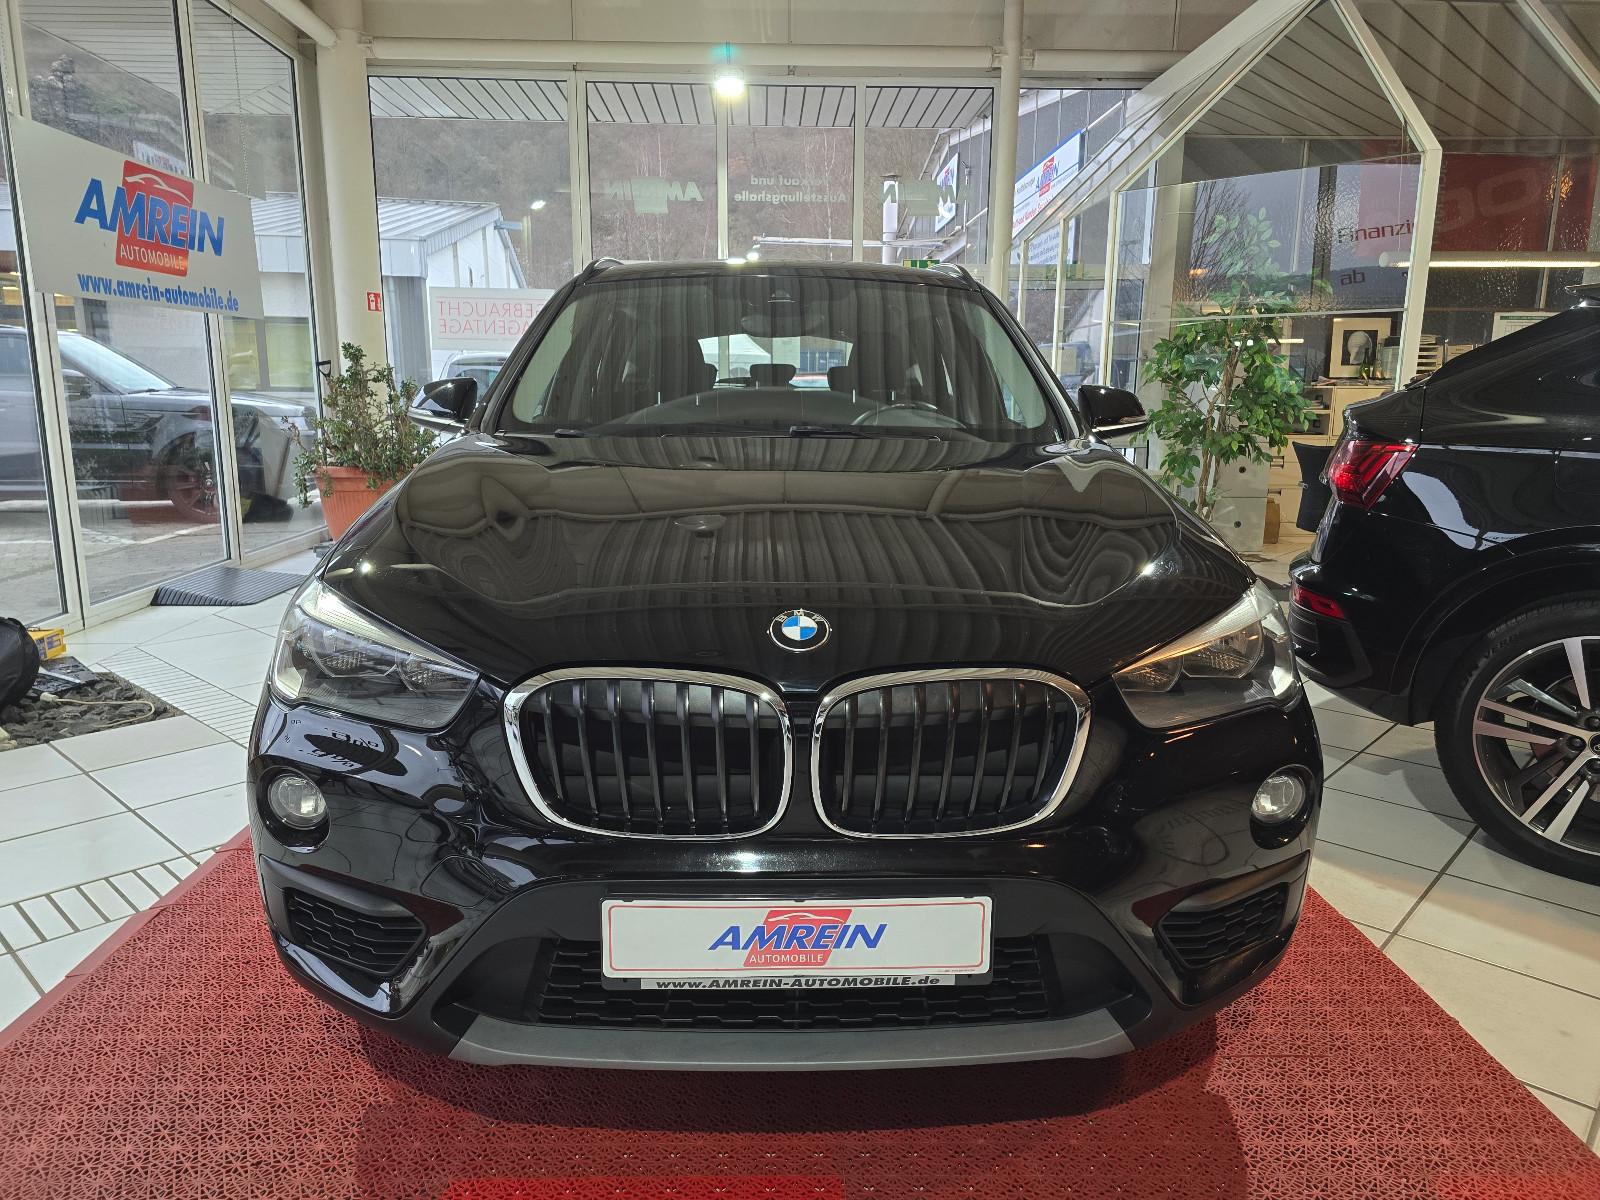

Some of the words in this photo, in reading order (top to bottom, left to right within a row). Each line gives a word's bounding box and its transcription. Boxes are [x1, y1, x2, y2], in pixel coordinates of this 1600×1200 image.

[74, 178, 225, 256] AMREIN
[120, 243, 185, 271] AUTOMOBILE
[77, 273, 239, 312] www.amrein-automobile.de
[707, 923, 888, 951] AMREIN
[749, 953, 824, 964] AUTOMOBILE
[656, 976, 940, 989] www.AMREIN-AUTOMOBILE.de
